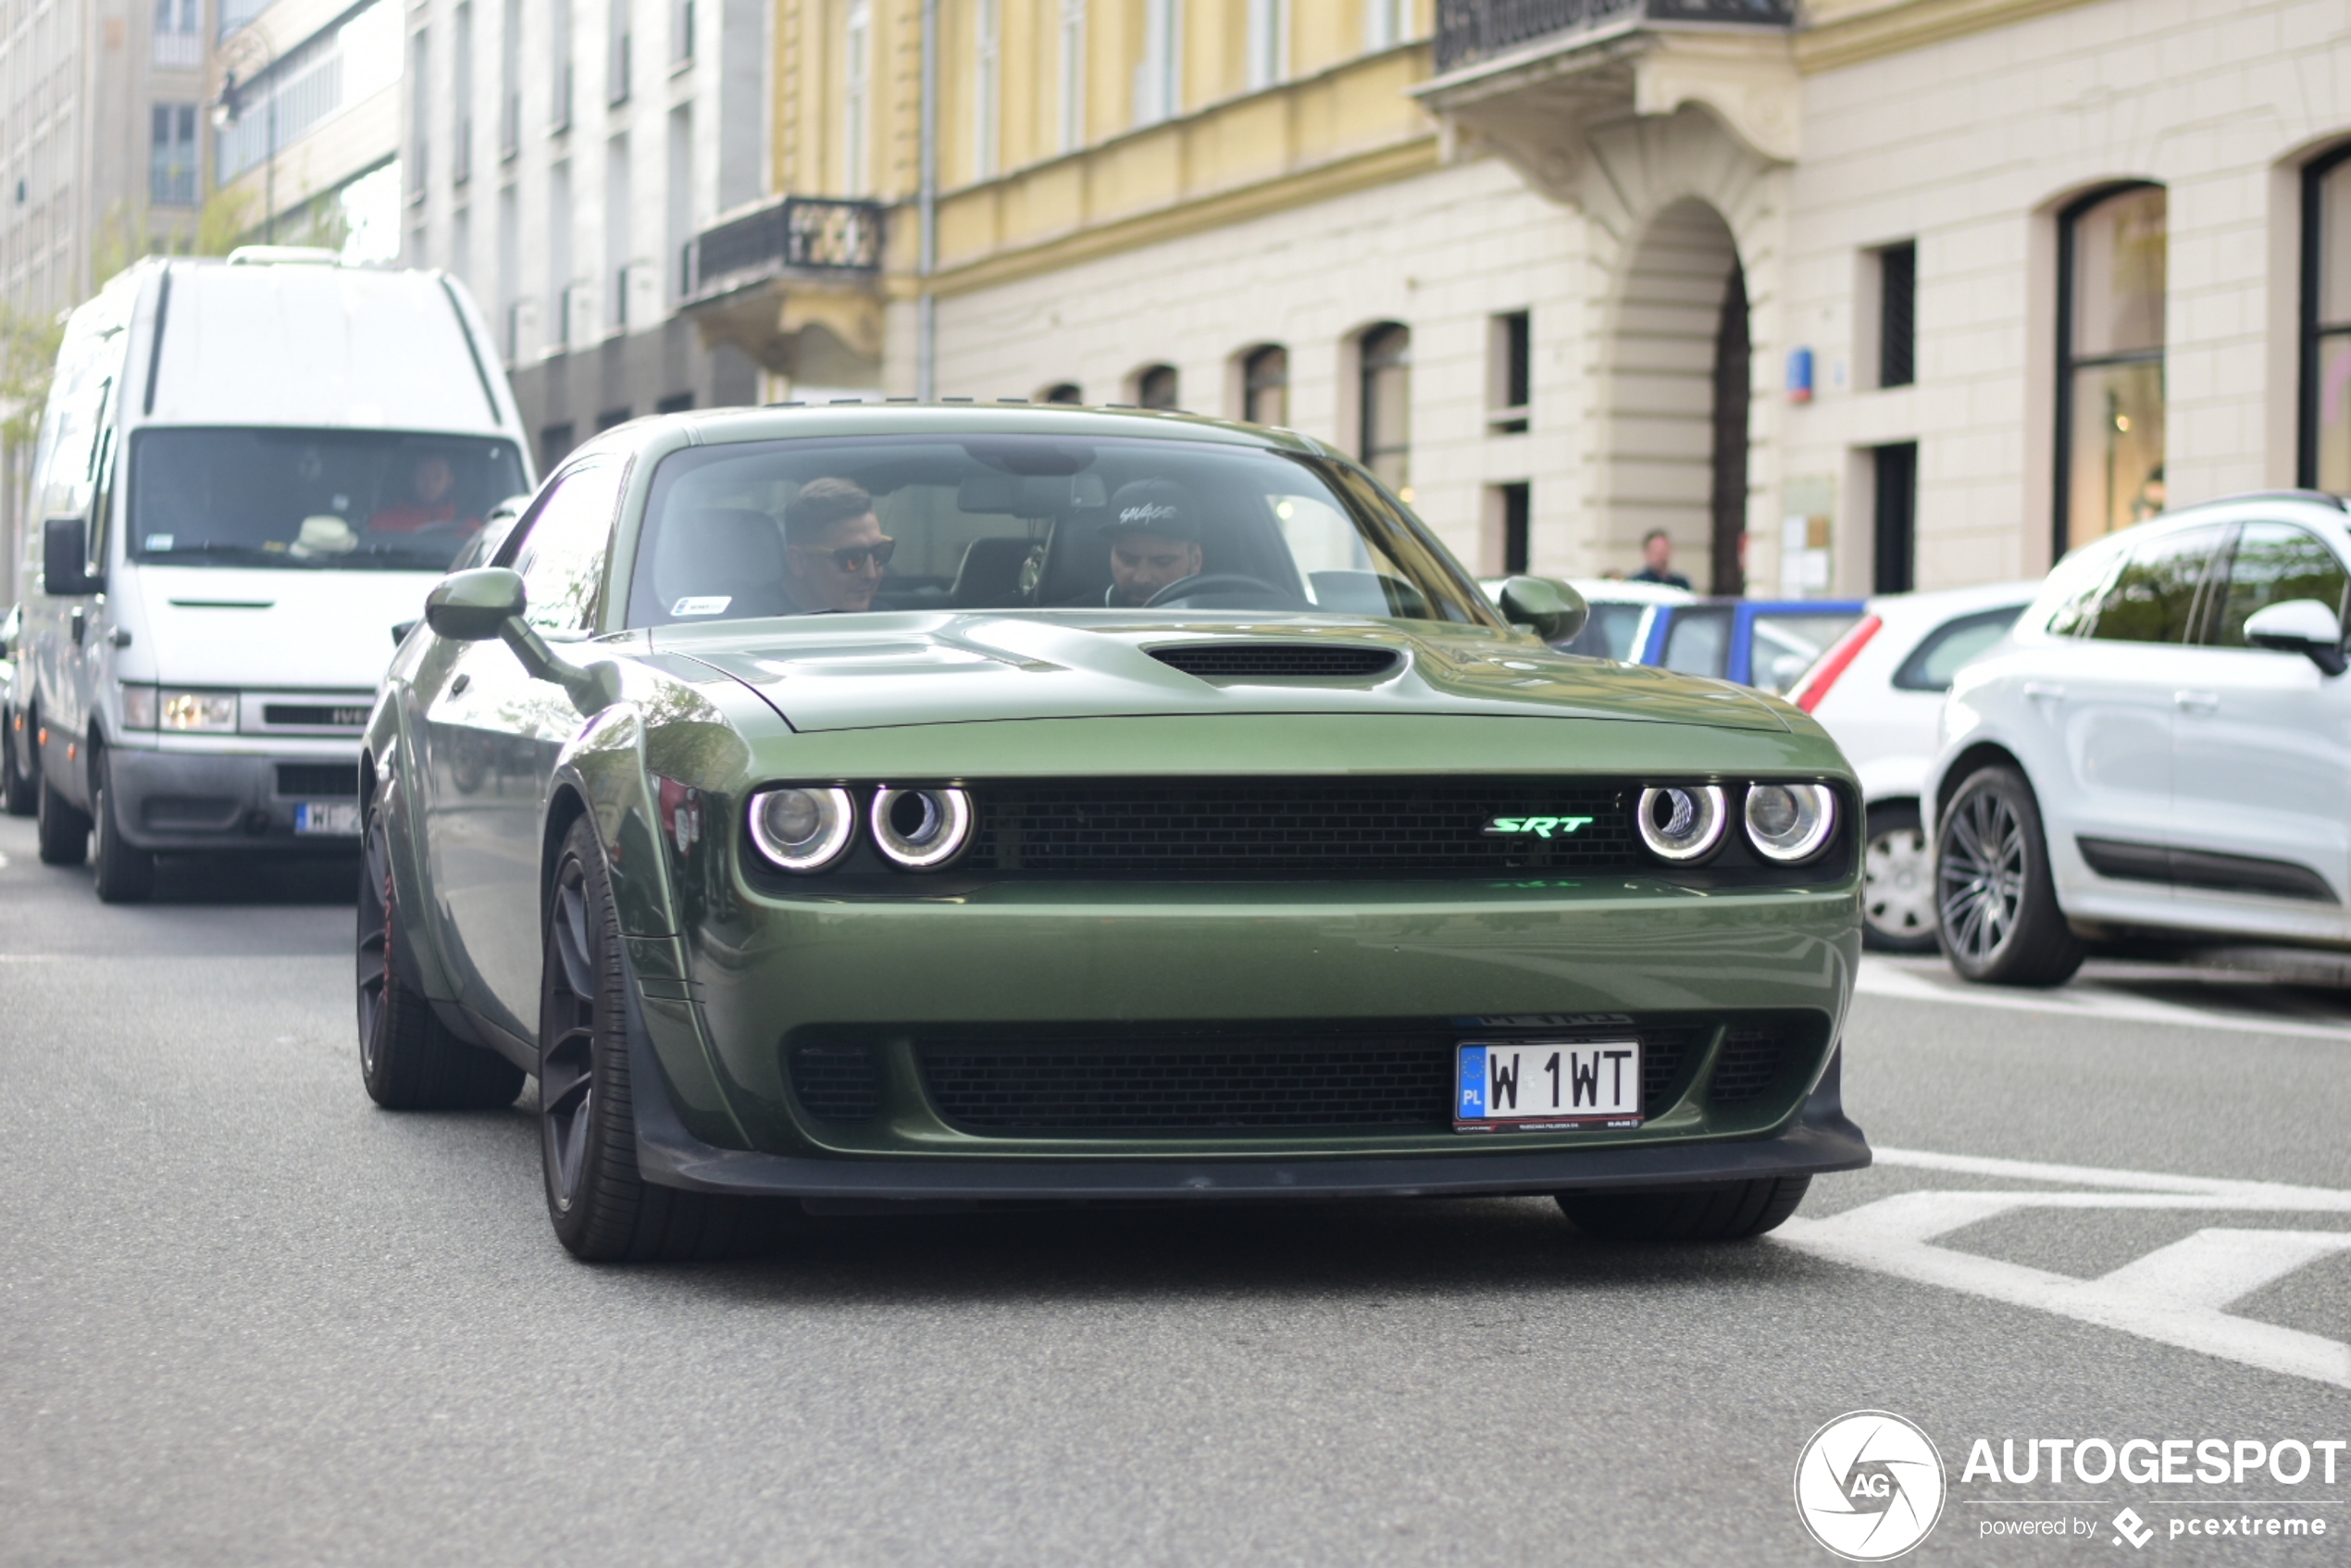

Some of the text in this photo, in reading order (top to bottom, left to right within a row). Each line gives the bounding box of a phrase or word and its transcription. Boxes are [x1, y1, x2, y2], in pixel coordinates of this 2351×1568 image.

[1484, 816, 1594, 839] SRT
[1489, 1051, 1633, 1110] W 1WT
[1462, 1089, 1482, 1105] PL
